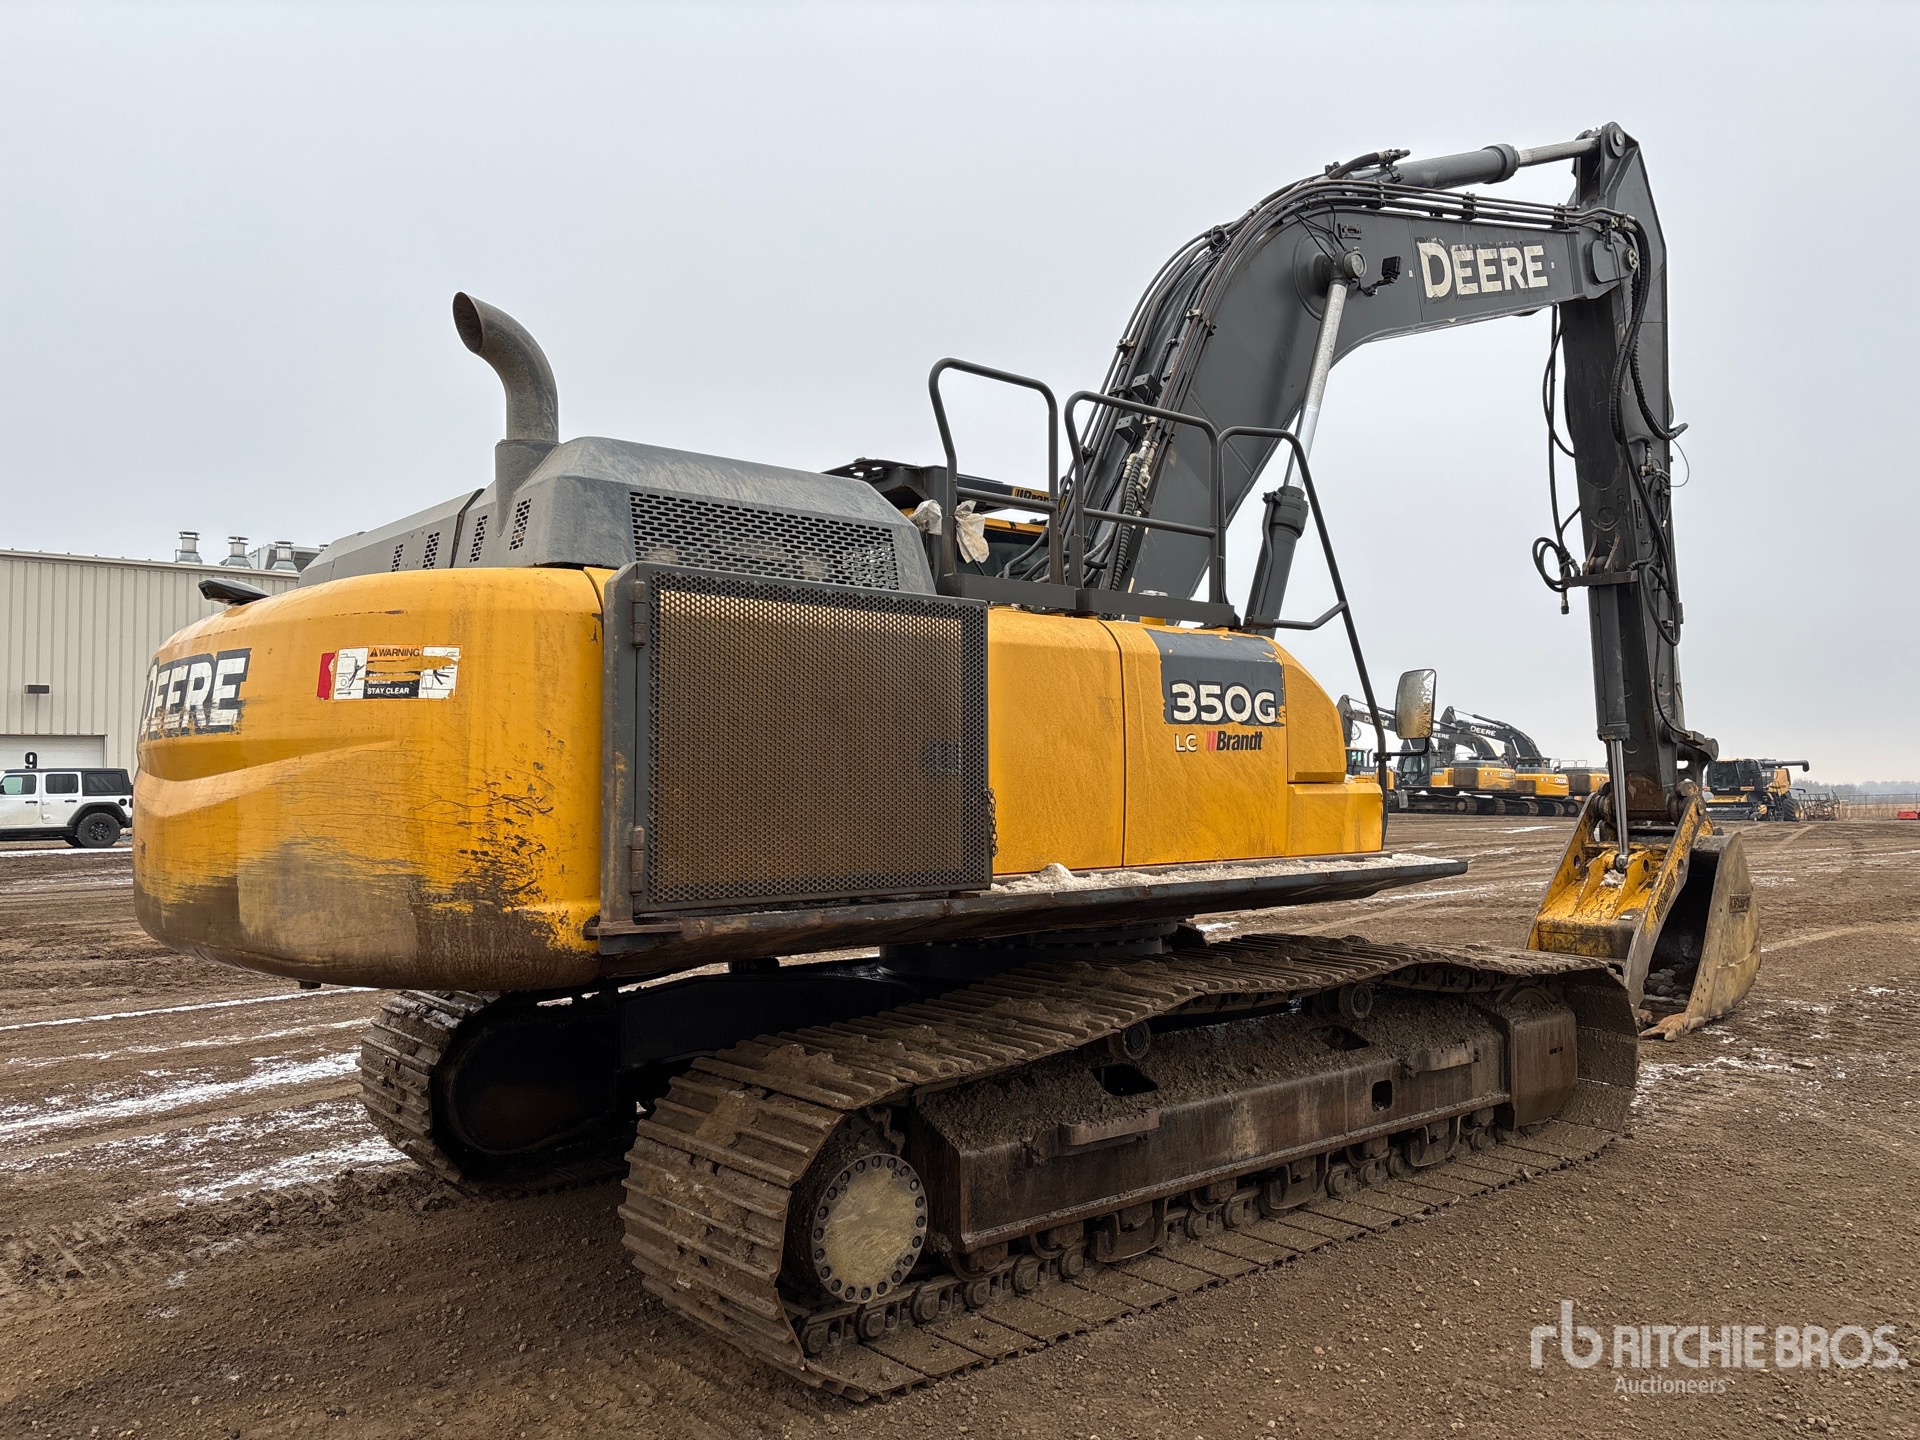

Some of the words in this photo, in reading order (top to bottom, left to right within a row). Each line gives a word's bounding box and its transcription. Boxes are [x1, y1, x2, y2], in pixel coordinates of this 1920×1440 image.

[1418, 241, 1549, 299] DEERE
[379, 648, 420, 657] WARNING
[140, 657, 247, 735] DEERE
[367, 687, 385, 695] STAY
[386, 687, 410, 695] CLEAR
[1171, 683, 1276, 723] 350G
[1363, 715, 1390, 727] DERE
[1431, 732, 1450, 740] EERE
[1470, 725, 1497, 737] DEERE
[1176, 735, 1196, 751] LC
[1216, 731, 1263, 751] Brandt
[25, 752, 37, 769] 9
